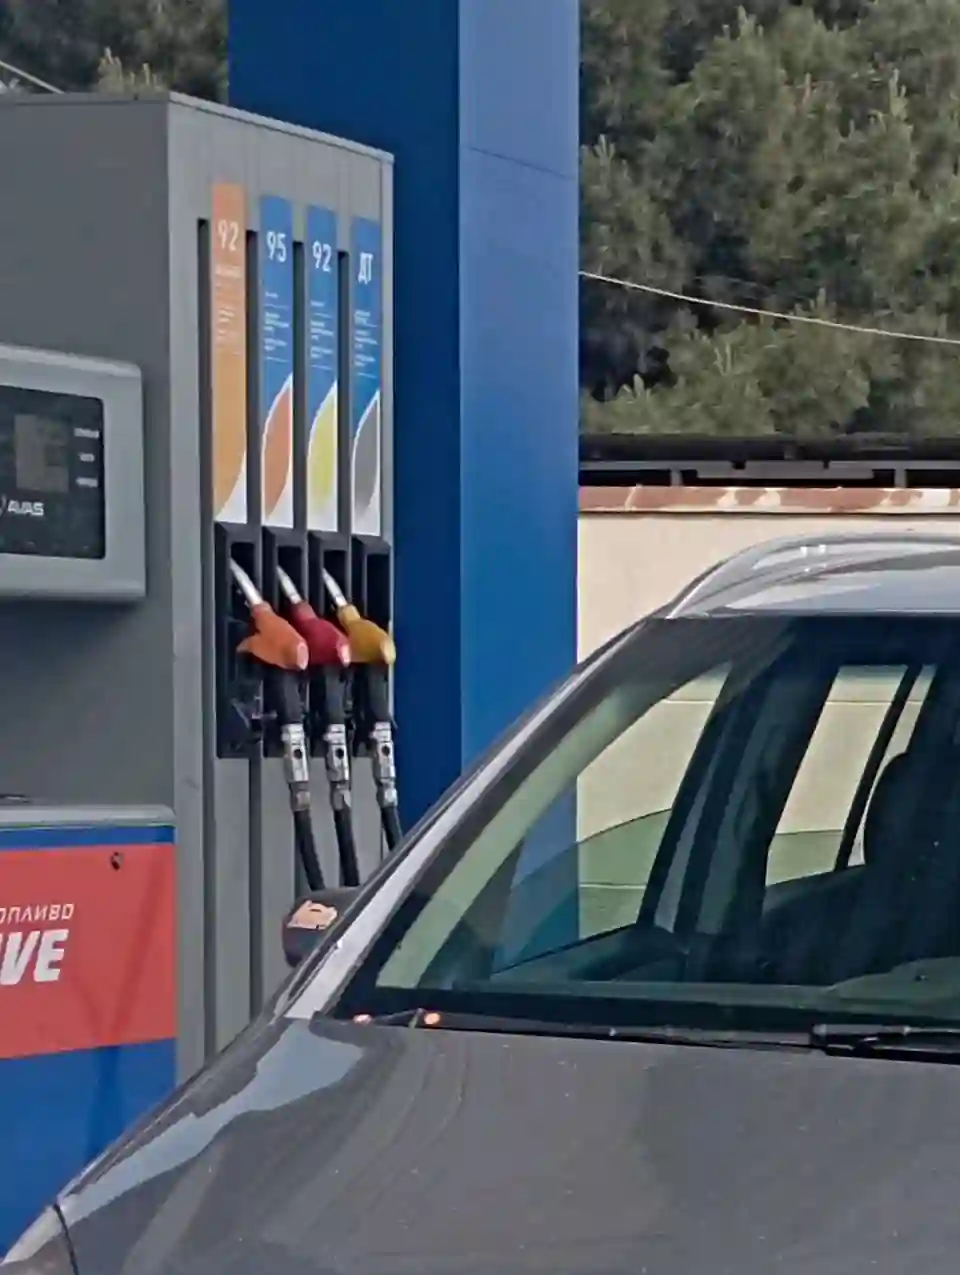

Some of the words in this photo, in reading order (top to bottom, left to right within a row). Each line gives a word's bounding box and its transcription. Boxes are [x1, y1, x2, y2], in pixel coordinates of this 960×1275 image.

[218, 219, 239, 252] 92
[266, 231, 287, 263] 95
[312, 240, 332, 272] 92
[0, 929, 69, 985] VE
